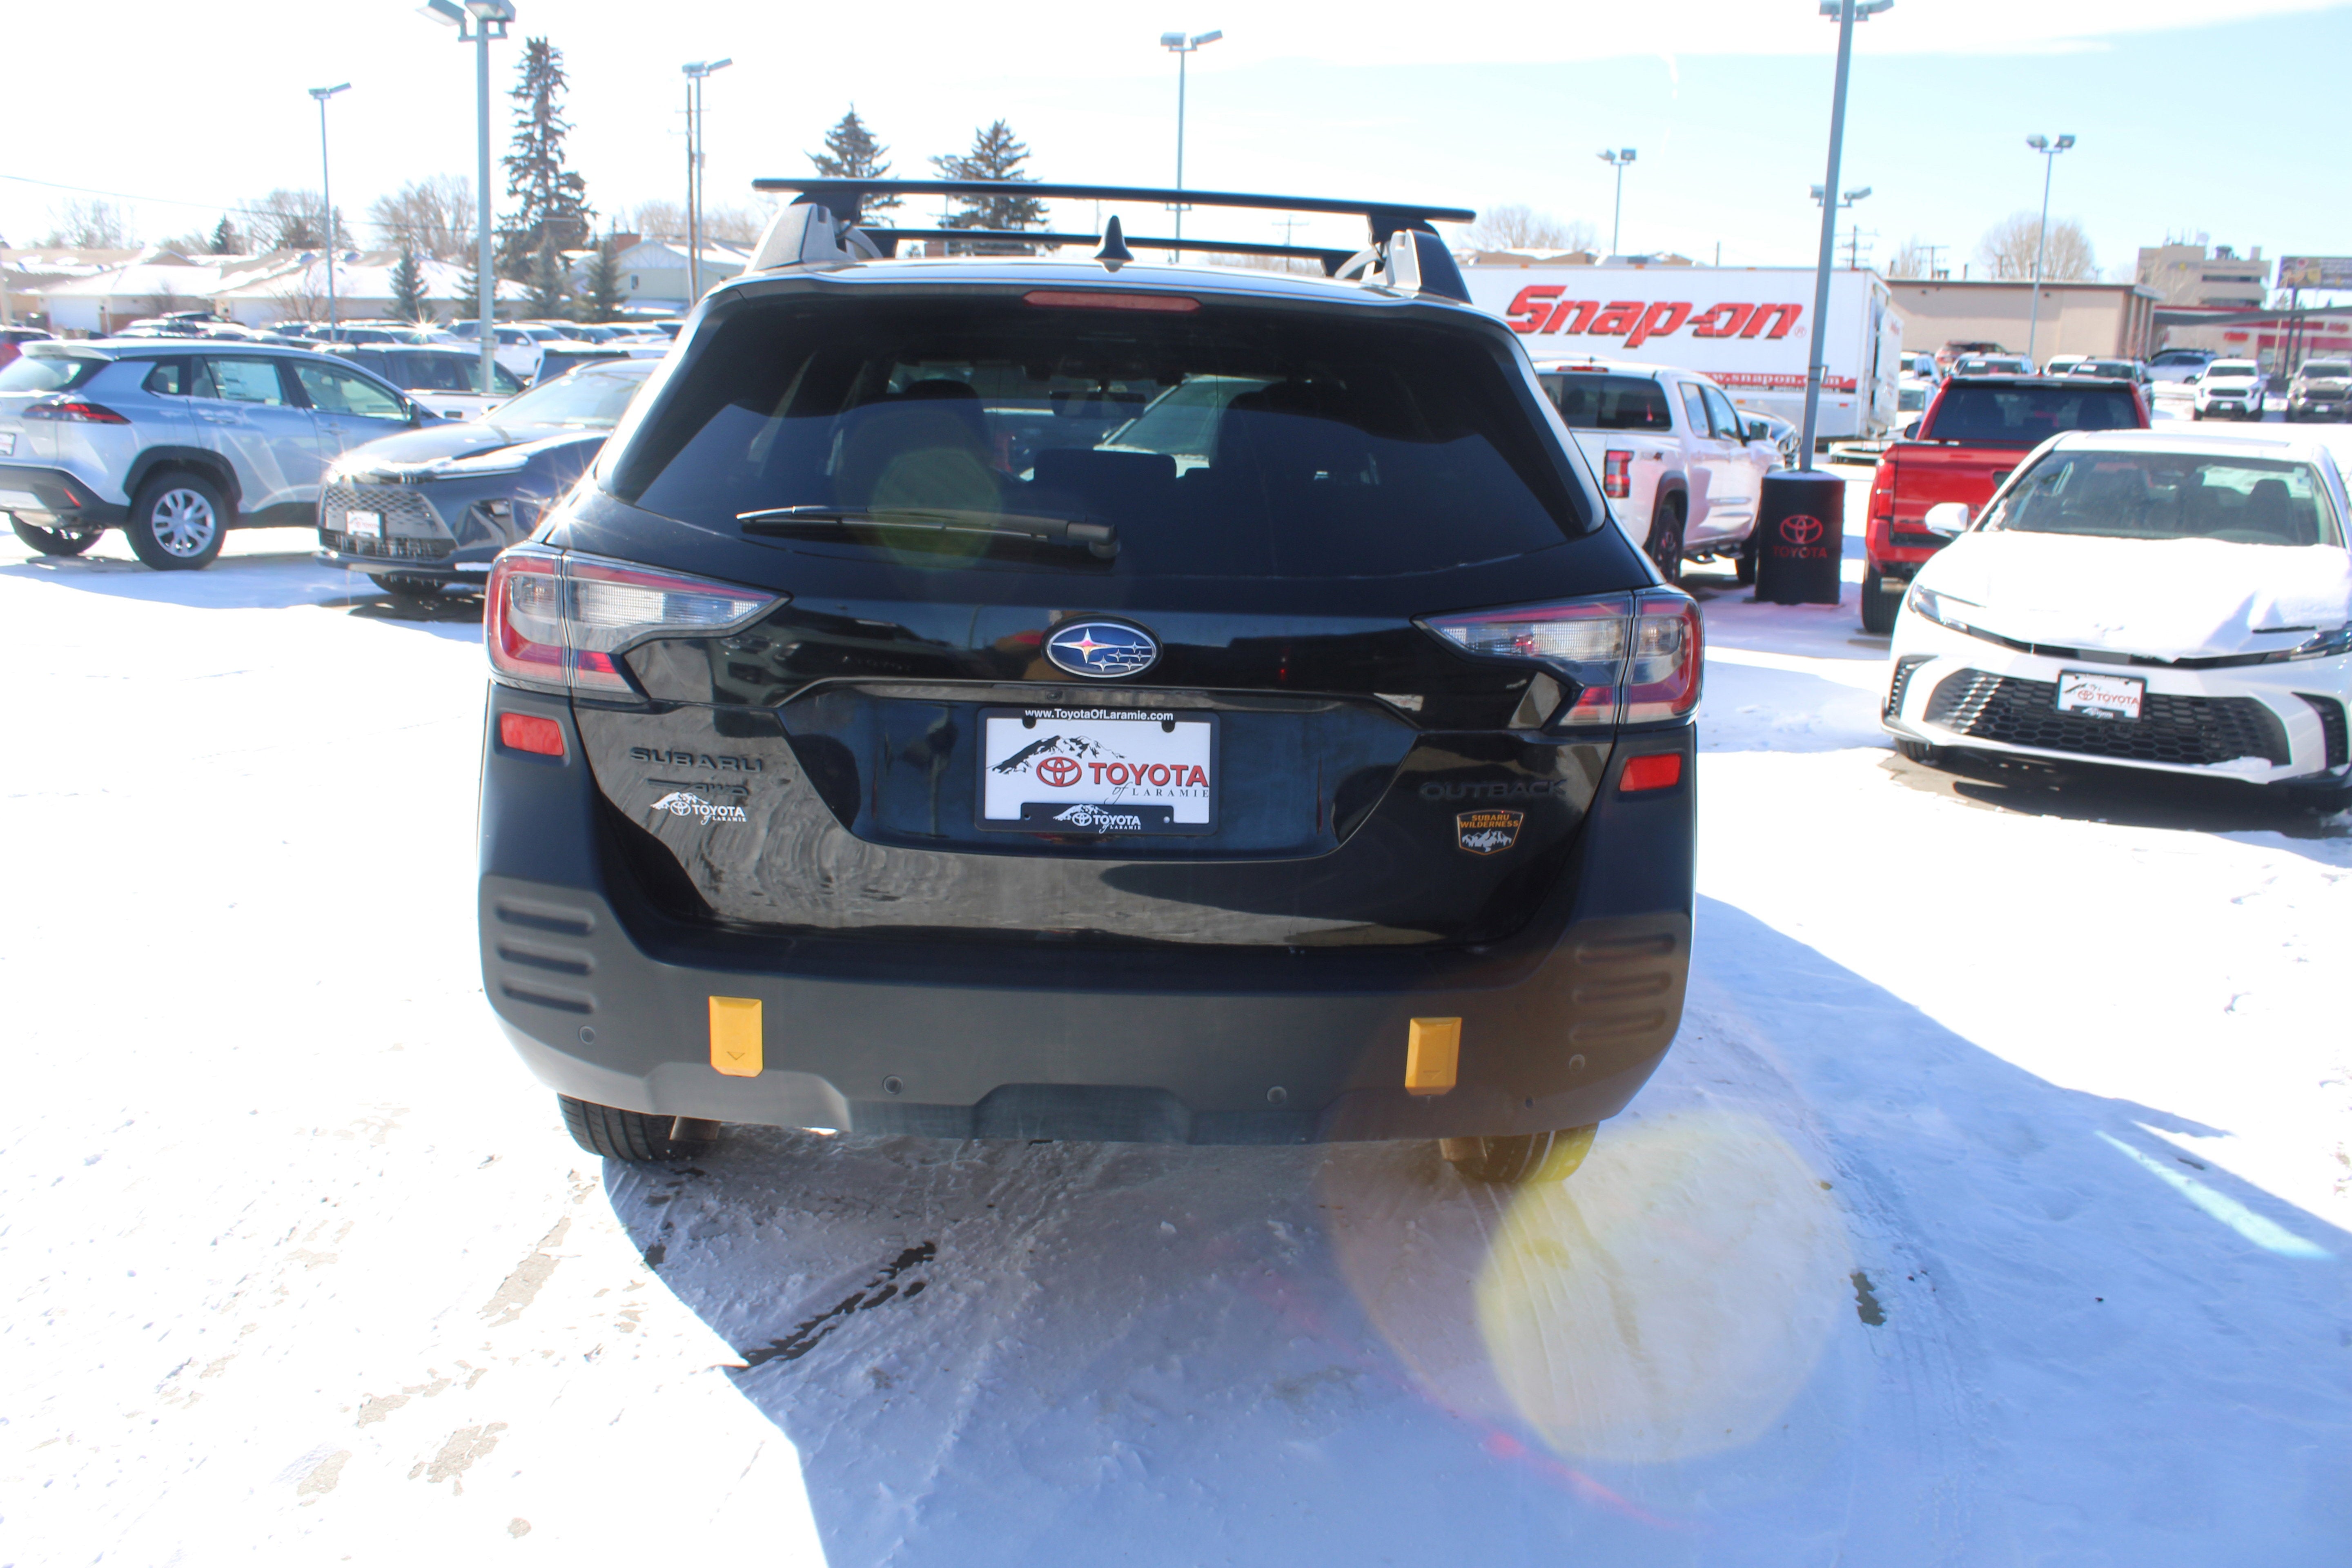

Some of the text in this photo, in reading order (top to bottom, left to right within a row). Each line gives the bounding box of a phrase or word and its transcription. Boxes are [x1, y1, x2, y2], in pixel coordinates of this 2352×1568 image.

[1506, 285, 1803, 348] Snap-on
[1773, 545, 1828, 558] TOYOTA
[2096, 693, 2140, 704] TOYOTA
[1025, 708, 1174, 721] www.ToyotaOfLaramie.com
[630, 747, 762, 772] SUBARU
[1088, 762, 1209, 788] TOYOTA
[1132, 788, 1209, 797] LARAMIE
[1420, 780, 1567, 798] OUTBACK
[691, 804, 746, 817] TOYOTA
[1093, 814, 1141, 826] TOYOTA
[1459, 820, 1519, 829] WILDERNESS
